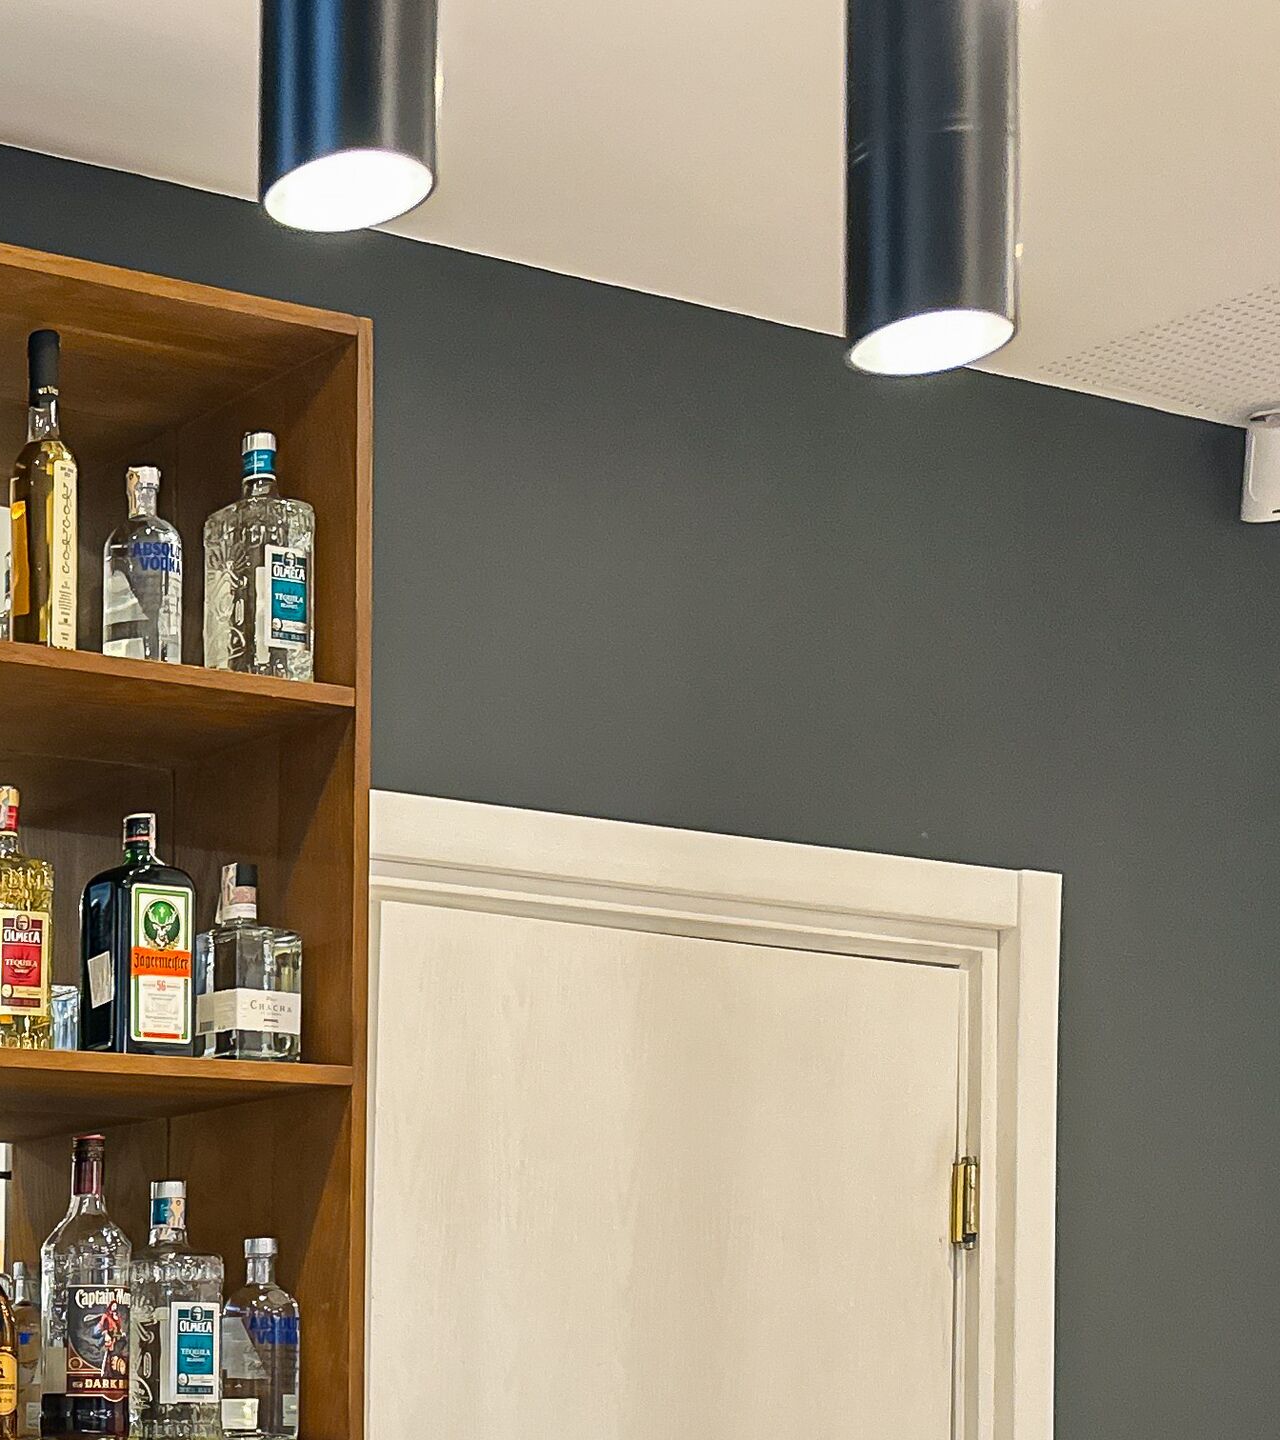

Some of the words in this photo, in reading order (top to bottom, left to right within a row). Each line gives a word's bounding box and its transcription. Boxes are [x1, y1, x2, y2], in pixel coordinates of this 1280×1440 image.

[273, 565, 306, 581] OLMECA
[3, 929, 40, 943] OLMECA
[5, 958, 38, 968] TEQUILA
[75, 1288, 115, 1309] Captain
[179, 1320, 212, 1333] OLMECA
[85, 1379, 116, 1389] DARK
